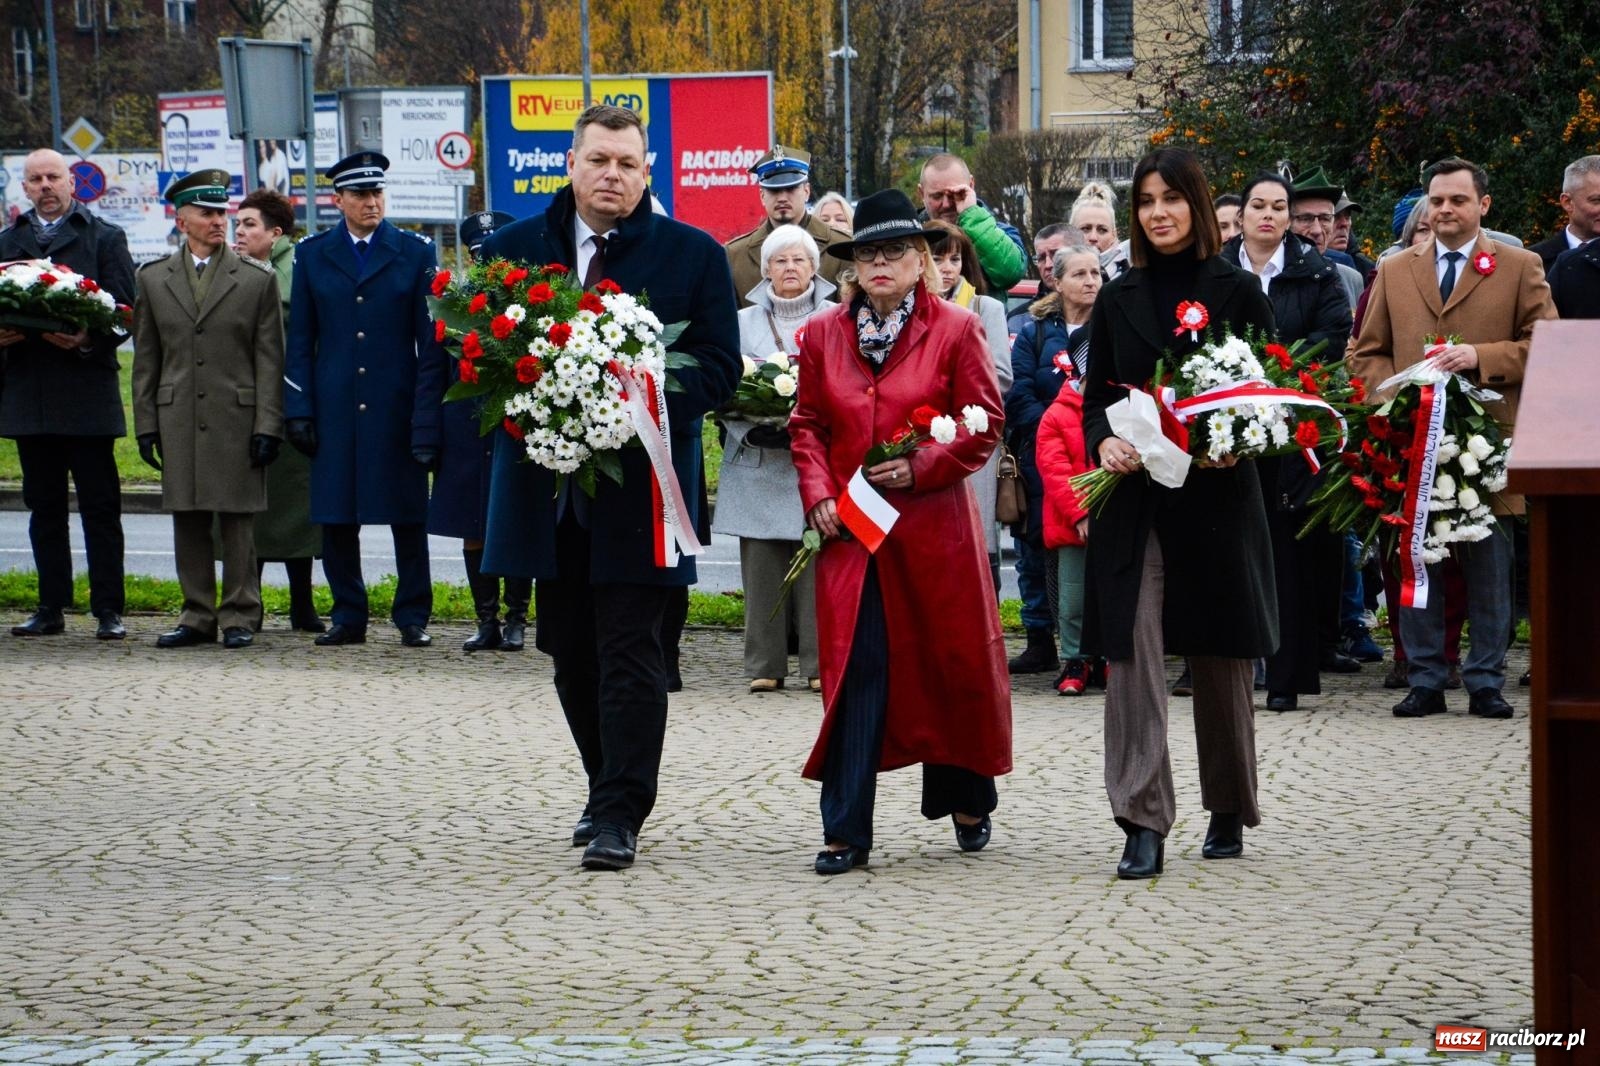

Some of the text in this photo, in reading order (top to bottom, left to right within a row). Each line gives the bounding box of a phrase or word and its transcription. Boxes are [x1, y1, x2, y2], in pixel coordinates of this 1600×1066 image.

[518, 94, 553, 116] RTV
[443, 139, 465, 159] 4 t
[681, 145, 766, 170] RACIBÓRZ
[508, 147, 566, 173] Tysiące
[513, 178, 530, 194] w
[681, 171, 748, 190] ul.Rybnicka
